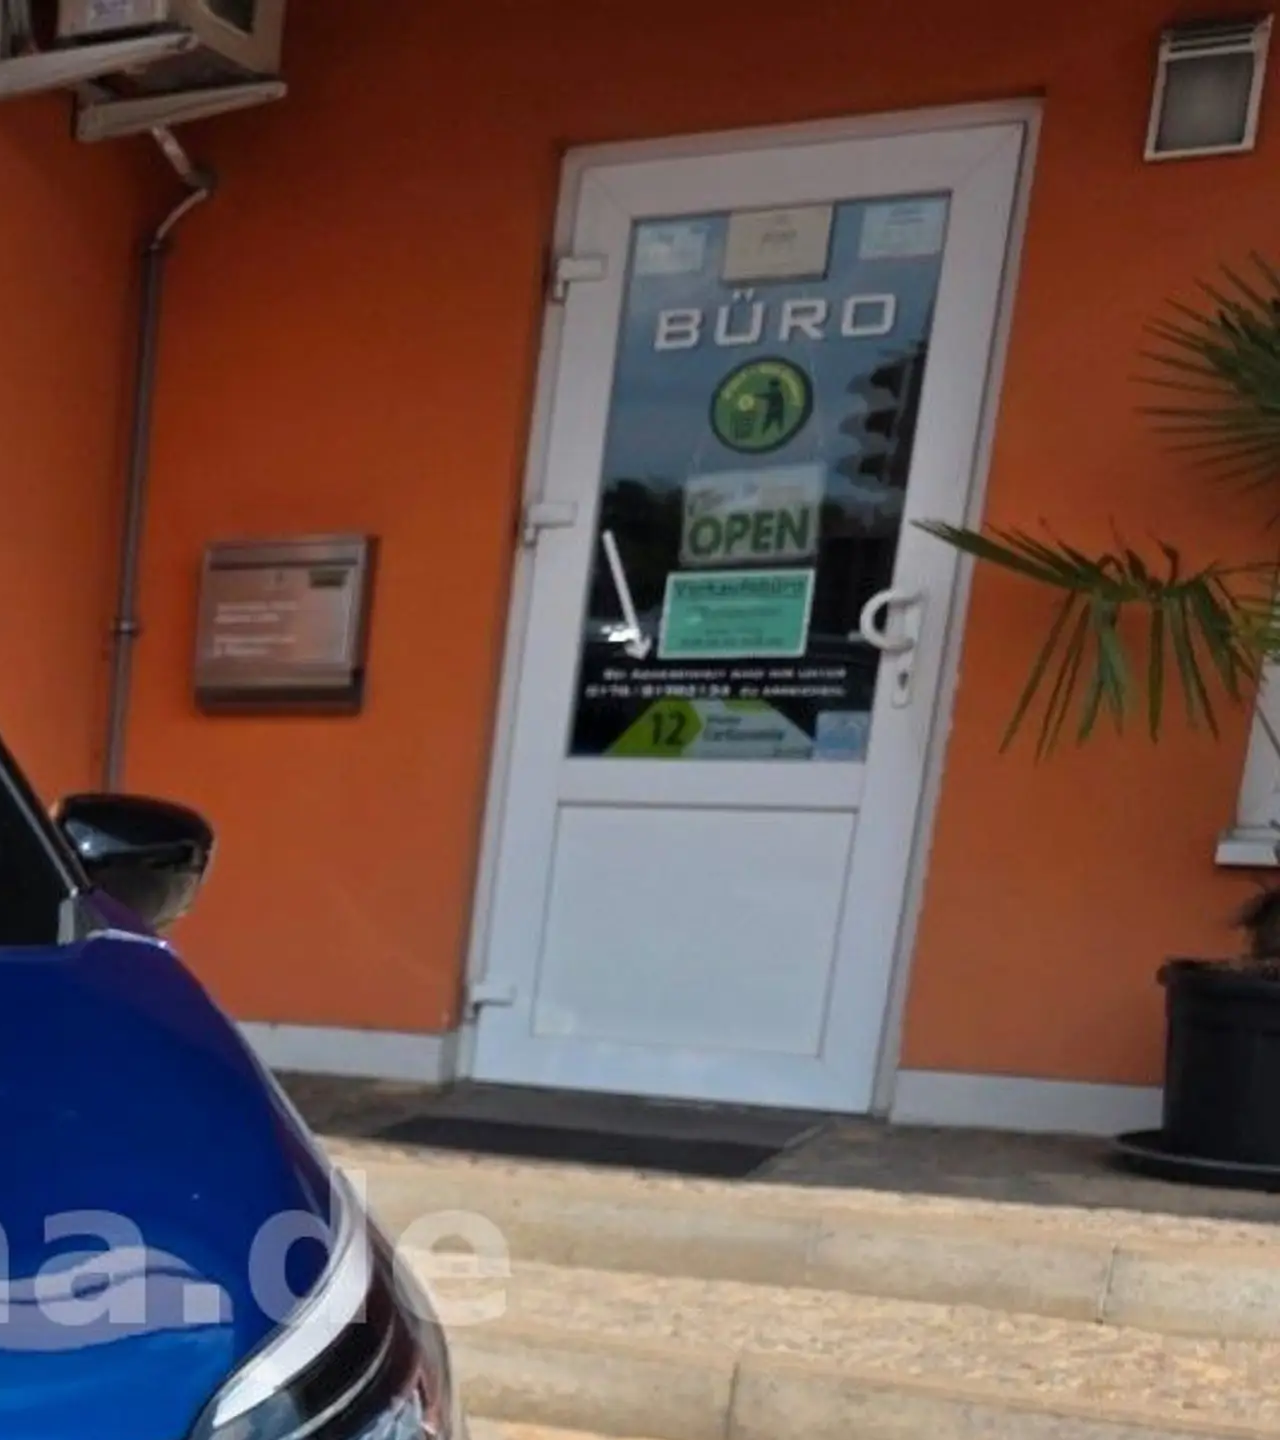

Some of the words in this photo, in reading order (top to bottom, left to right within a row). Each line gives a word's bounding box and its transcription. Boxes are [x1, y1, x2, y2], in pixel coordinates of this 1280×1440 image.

[654, 288, 895, 351] BÜRO
[689, 507, 811, 556] OPEN
[652, 711, 688, 745] 12
